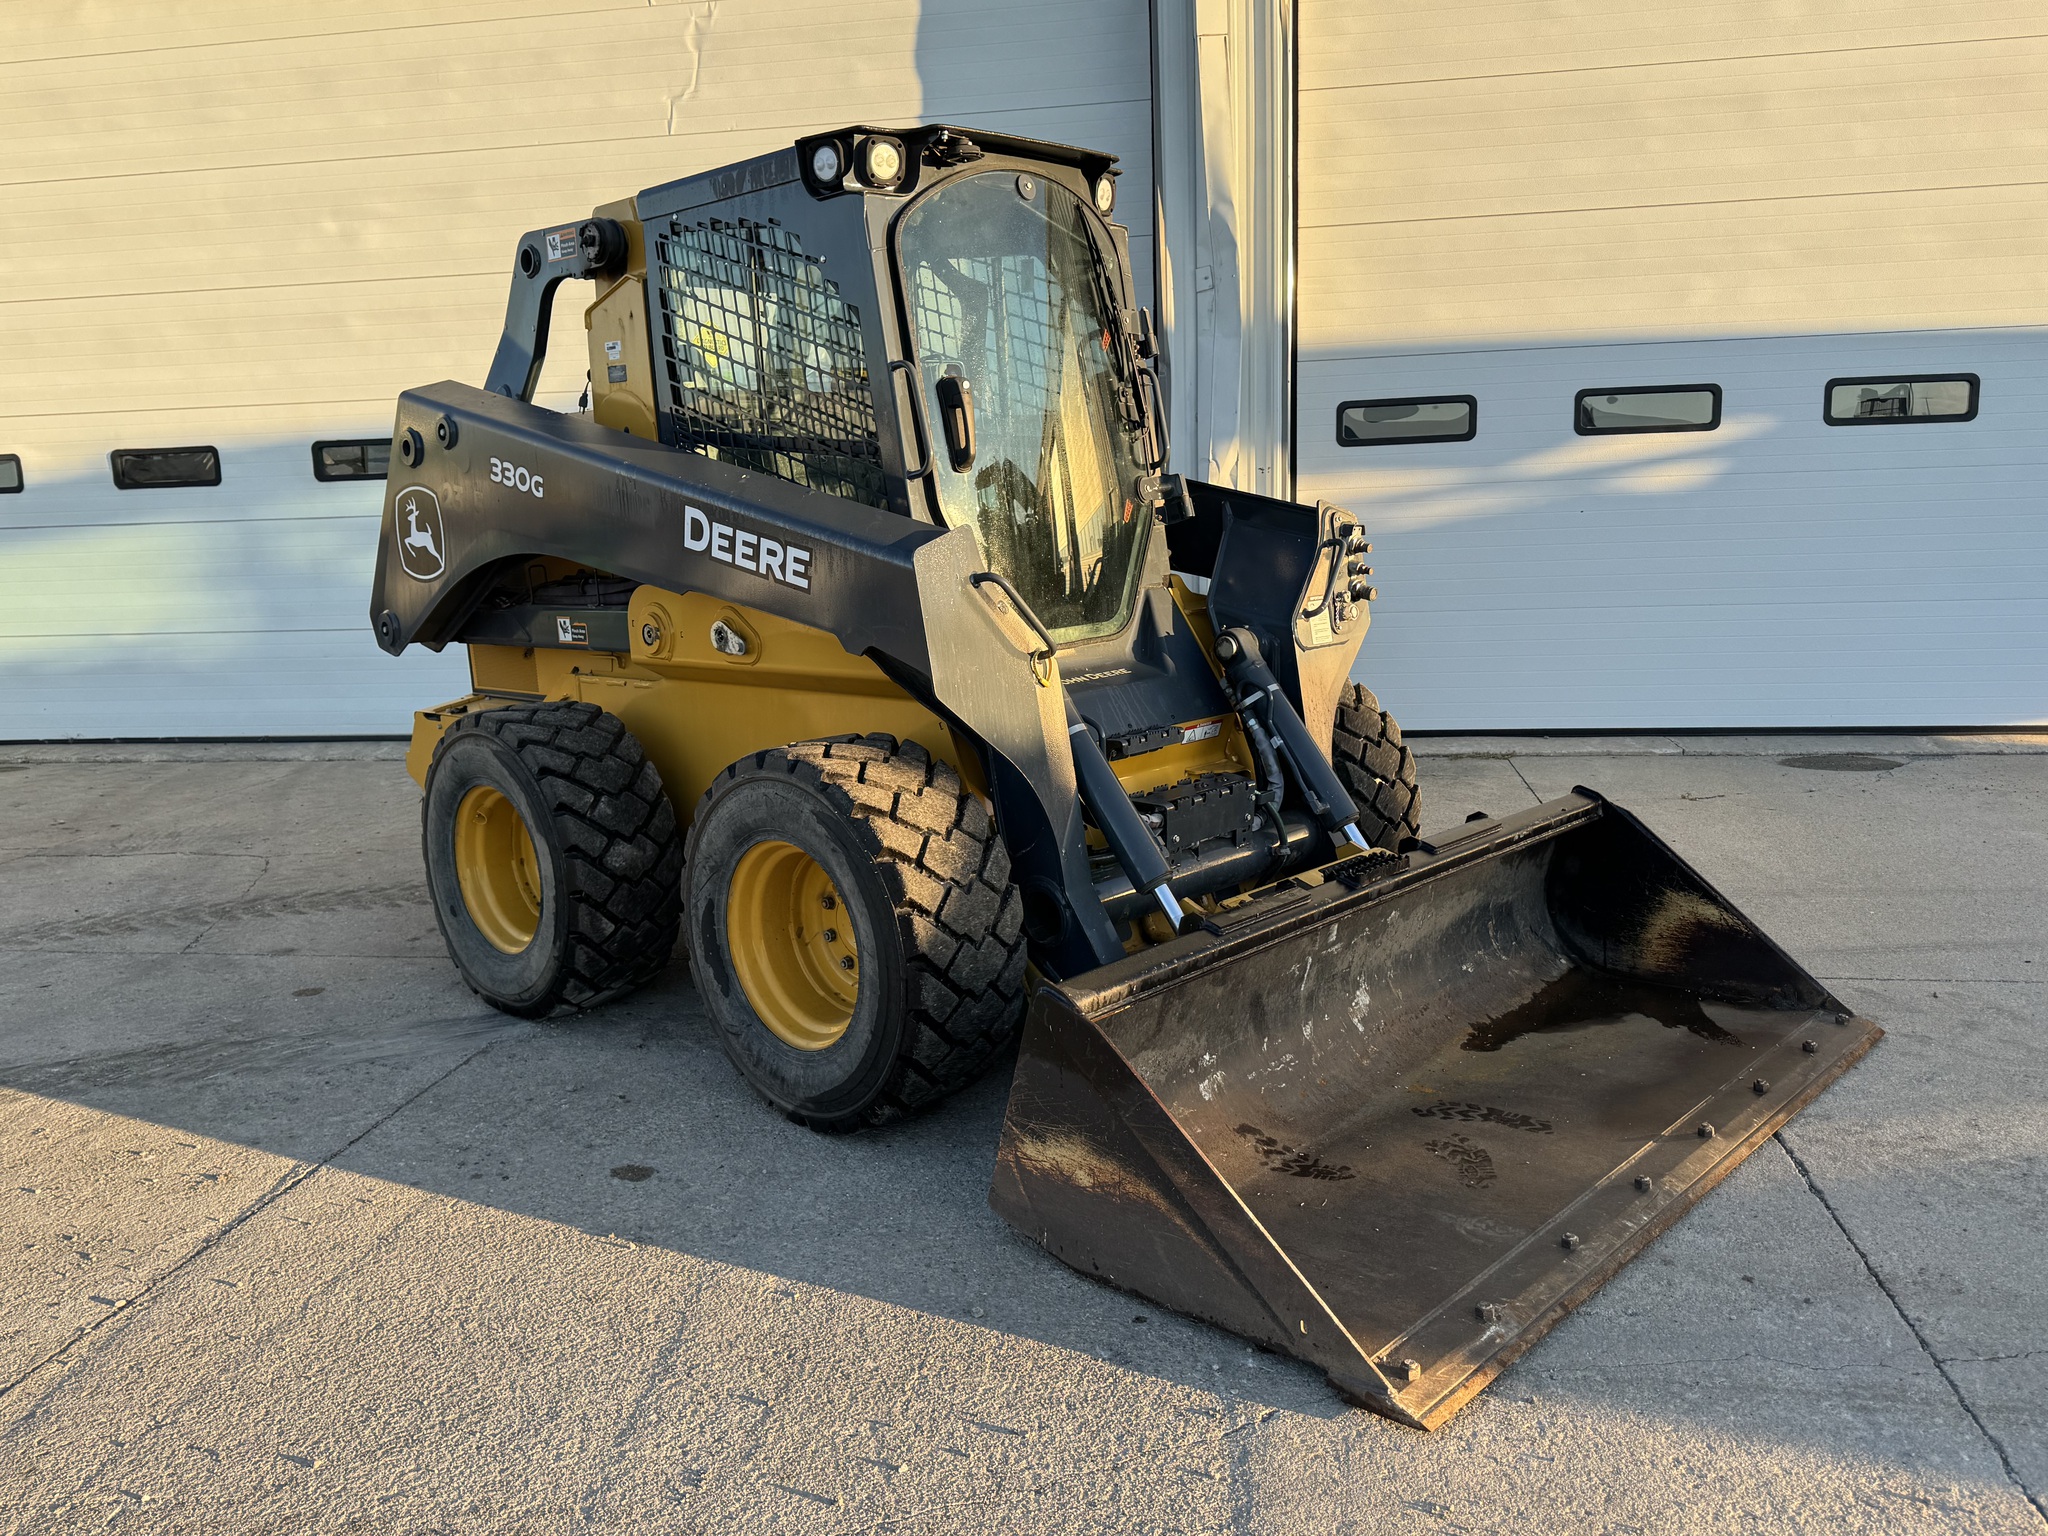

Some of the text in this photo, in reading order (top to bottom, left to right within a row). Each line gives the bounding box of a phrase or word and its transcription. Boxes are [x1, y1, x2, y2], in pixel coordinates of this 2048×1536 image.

[490, 457, 543, 498] 330G
[684, 505, 810, 589] DEERE
[1061, 668, 1132, 685] OHN DEERE
